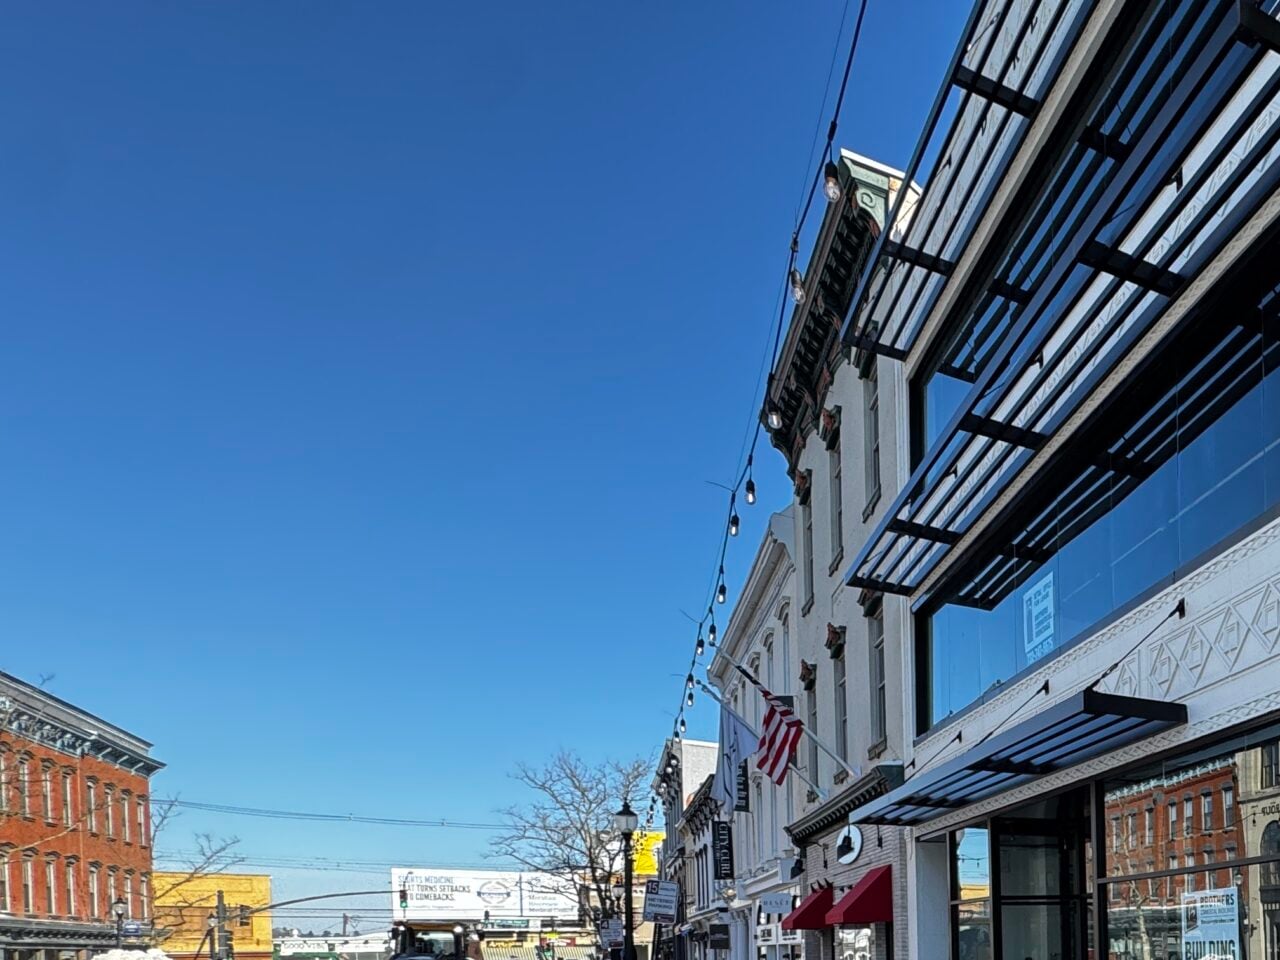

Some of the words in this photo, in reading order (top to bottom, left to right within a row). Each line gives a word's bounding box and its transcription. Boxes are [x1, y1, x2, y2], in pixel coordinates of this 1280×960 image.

[719, 823, 729, 847] CITY
[720, 849, 731, 877] CURL
[398, 884, 415, 892] TAT
[416, 884, 438, 892] TURNS
[440, 885, 471, 893] SETBACKS
[1185, 939, 1236, 960] BUILDING
